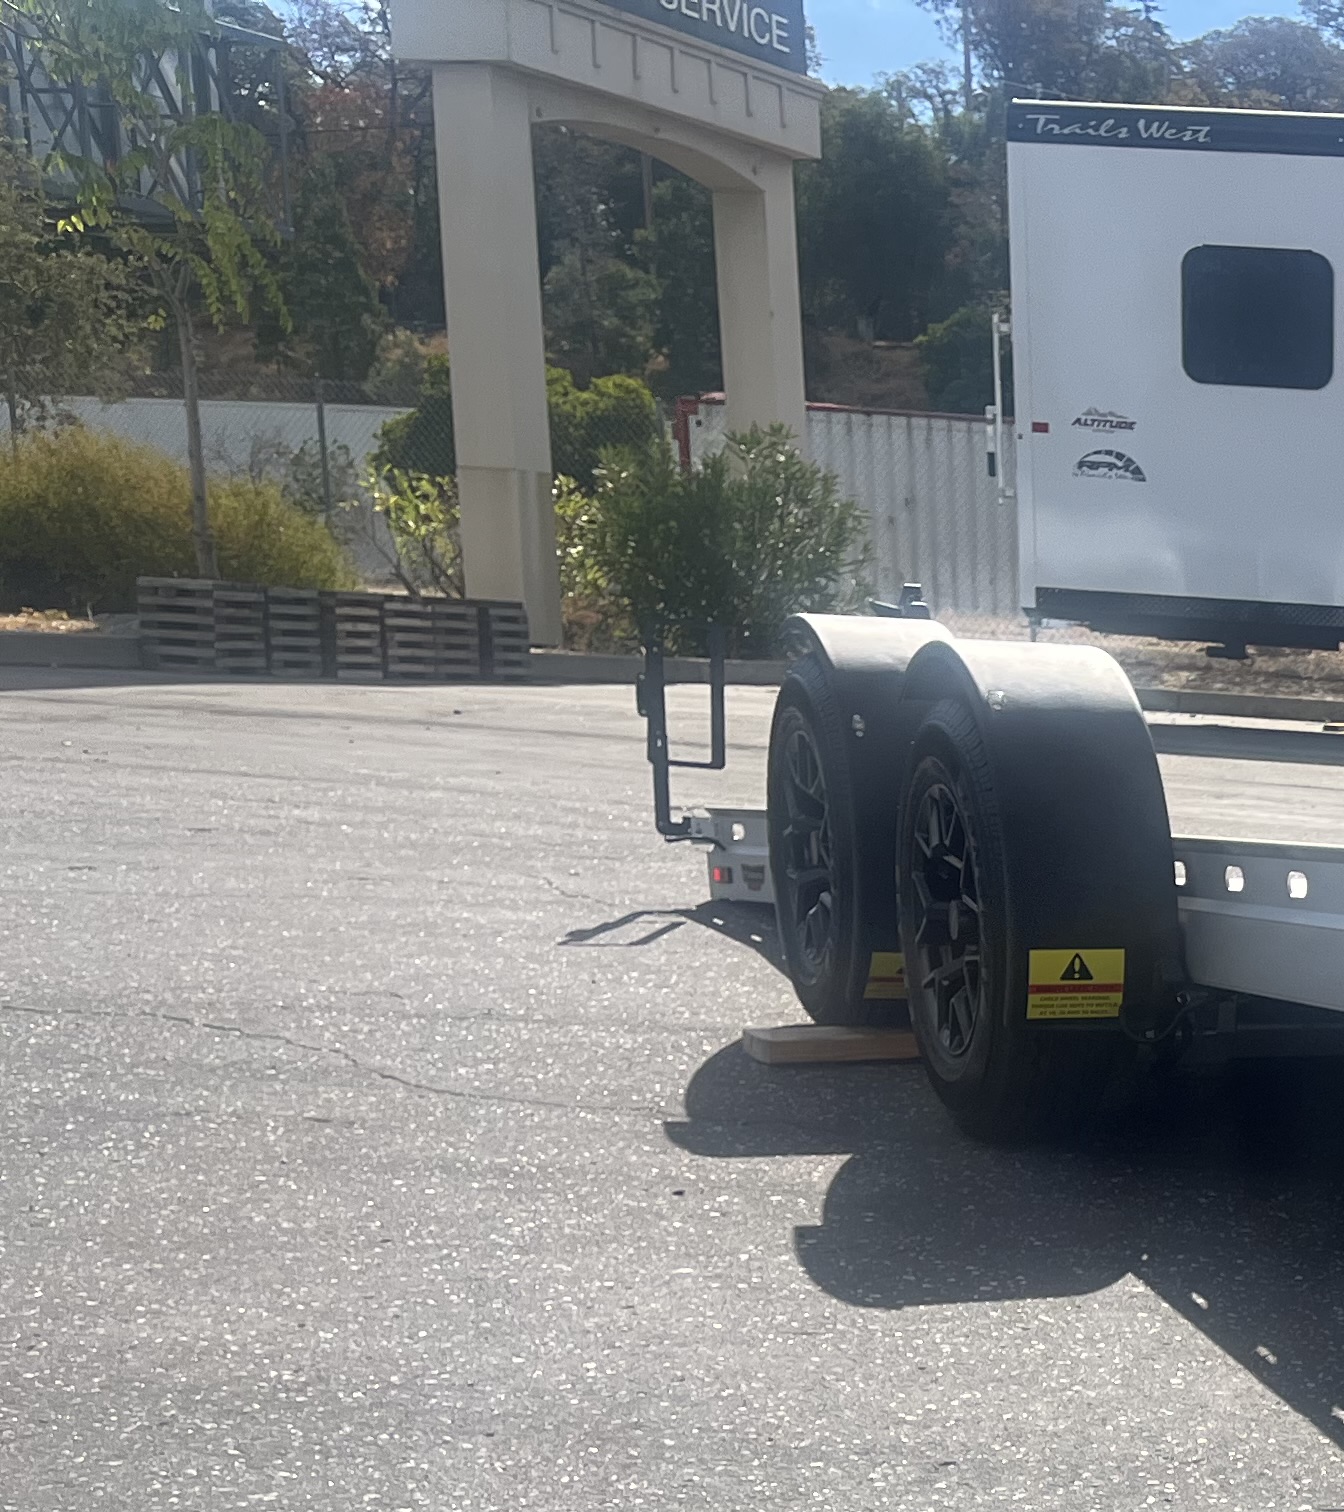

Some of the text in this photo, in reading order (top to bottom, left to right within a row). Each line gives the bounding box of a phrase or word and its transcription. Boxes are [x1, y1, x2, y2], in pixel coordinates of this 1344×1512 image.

[660, 0, 791, 53] ERVICE
[1025, 114, 1212, 143] Trails West
[1071, 417, 1137, 431] ALTITUDE
